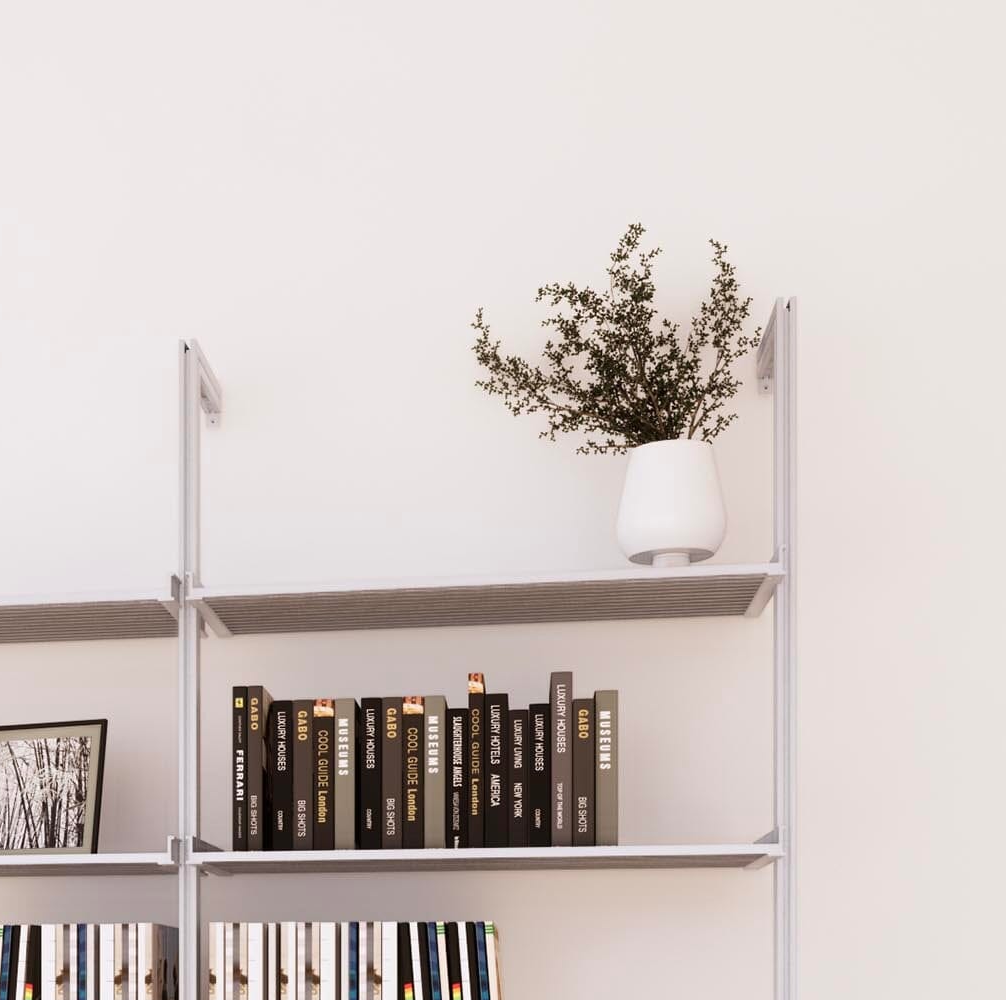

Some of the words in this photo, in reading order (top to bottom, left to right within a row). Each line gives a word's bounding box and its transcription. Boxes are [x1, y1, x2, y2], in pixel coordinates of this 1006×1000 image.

[250, 697, 258, 730] GABO
[556, 684, 566, 716] LUXURY
[277, 711, 286, 740] LUXURY
[298, 710, 308, 741] GABO
[366, 708, 375, 737] LUXURY
[387, 708, 397, 738] GABO
[471, 708, 480, 738] COOL
[490, 704, 501, 733] LUXURY
[513, 720, 522, 746] LUXURY
[534, 714, 544, 741] LUXURY
[578, 709, 589, 739] GABO
[318, 730, 328, 756] COOL
[338, 718, 349, 776] MUSEUMS
[408, 728, 418, 754] COOL
[428, 715, 439, 774] MUSEUMS
[452, 716, 462, 765] SLAUGHTERHOUSE
[490, 735, 501, 764] HOTELS
[556, 719, 566, 753] HOUSES
[600, 710, 611, 770] MUSEUMS
[277, 741, 286, 771] HOUSES
[366, 739, 375, 769] HOUSES
[471, 741, 480, 774] GUIDE
[513, 747, 522, 768] LIVING
[534, 743, 544, 771] HOUSES
[236, 750, 244, 800] FERRARI
[318, 759, 328, 787] GUIDE
[408, 756, 418, 785] GUIDE
[452, 766, 462, 787] ANGELS
[250, 795, 258, 808] BIG
[387, 798, 395, 810] BIG
[471, 778, 480, 815] London
[490, 774, 501, 807] AMERICA
[513, 782, 522, 798] NEW
[578, 796, 587, 808] BIG
[297, 800, 306, 812] BIG
[318, 790, 328, 823] London
[408, 788, 418, 822] London
[513, 799, 522, 818] YORK
[250, 809, 258, 835] SHOTS
[297, 813, 306, 837] SHOTS
[387, 812, 395, 835] SHOTS
[578, 810, 587, 833] SHOTS
